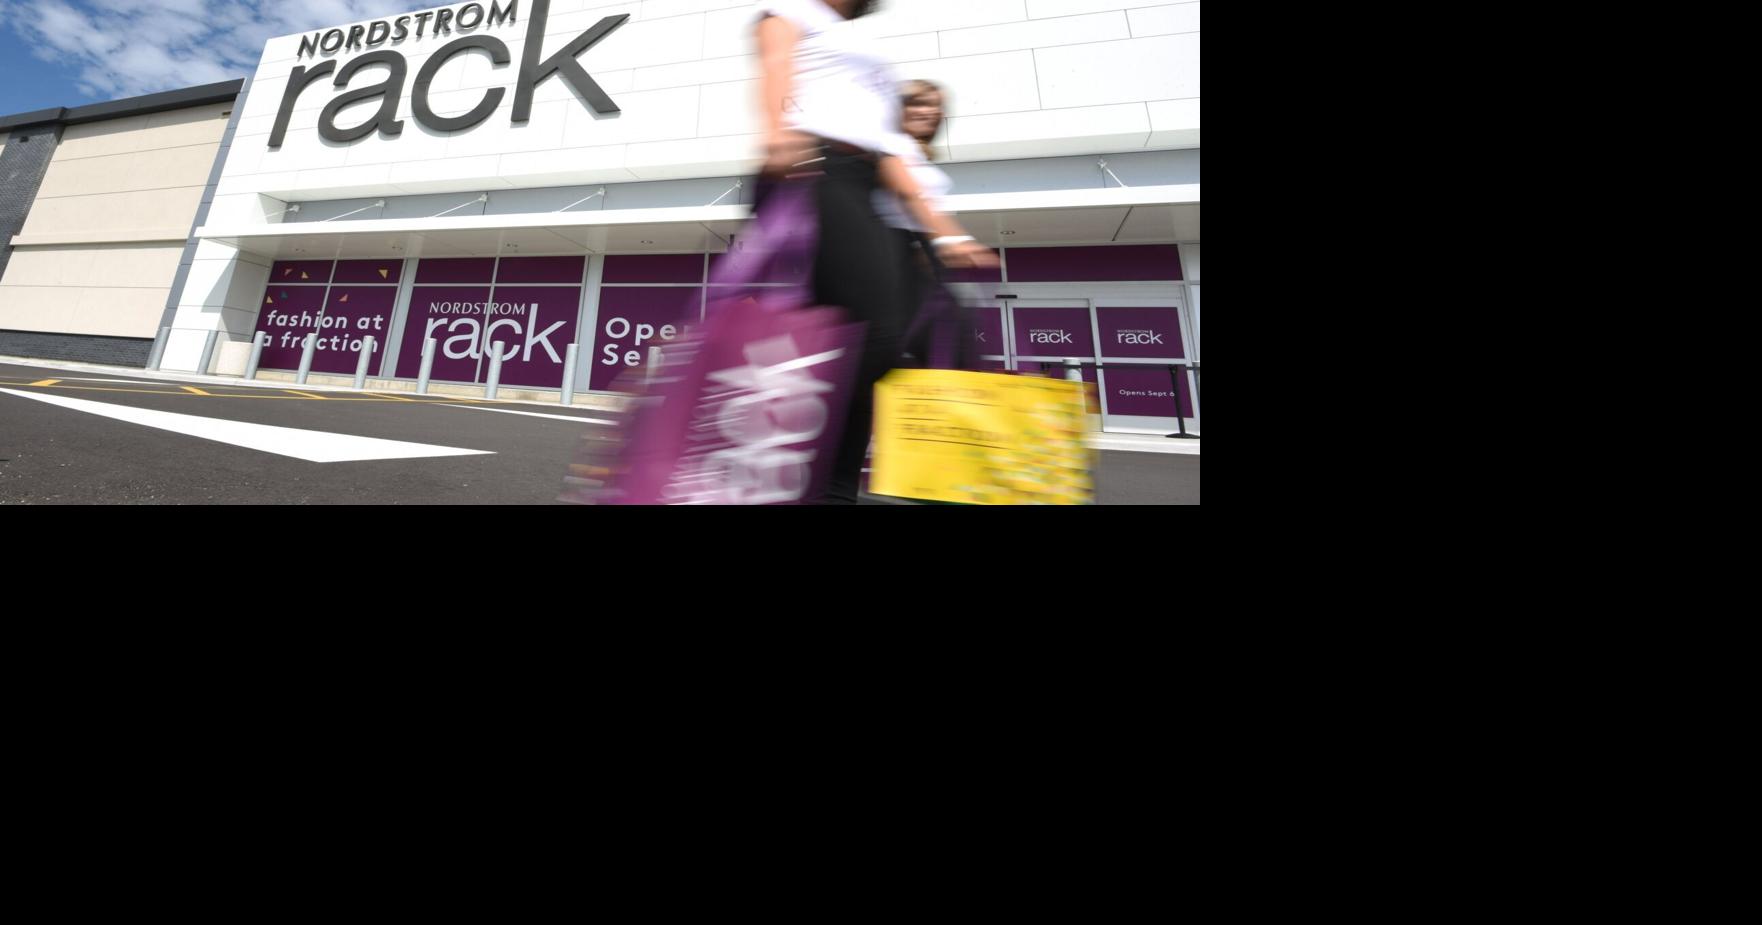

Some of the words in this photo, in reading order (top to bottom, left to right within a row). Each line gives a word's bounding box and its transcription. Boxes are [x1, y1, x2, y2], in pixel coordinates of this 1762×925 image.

[297, 0, 517, 57] NORDSTROM
[267, 0, 631, 148] rack
[429, 301, 526, 316] NORDSTROM
[267, 310, 348, 329] fashion
[356, 314, 384, 330] at
[420, 303, 568, 364] rack
[1029, 329, 1073, 344] rack
[1117, 330, 1164, 344] rack
[1119, 389, 1146, 397] Opens
[1147, 390, 1168, 398] Sept
